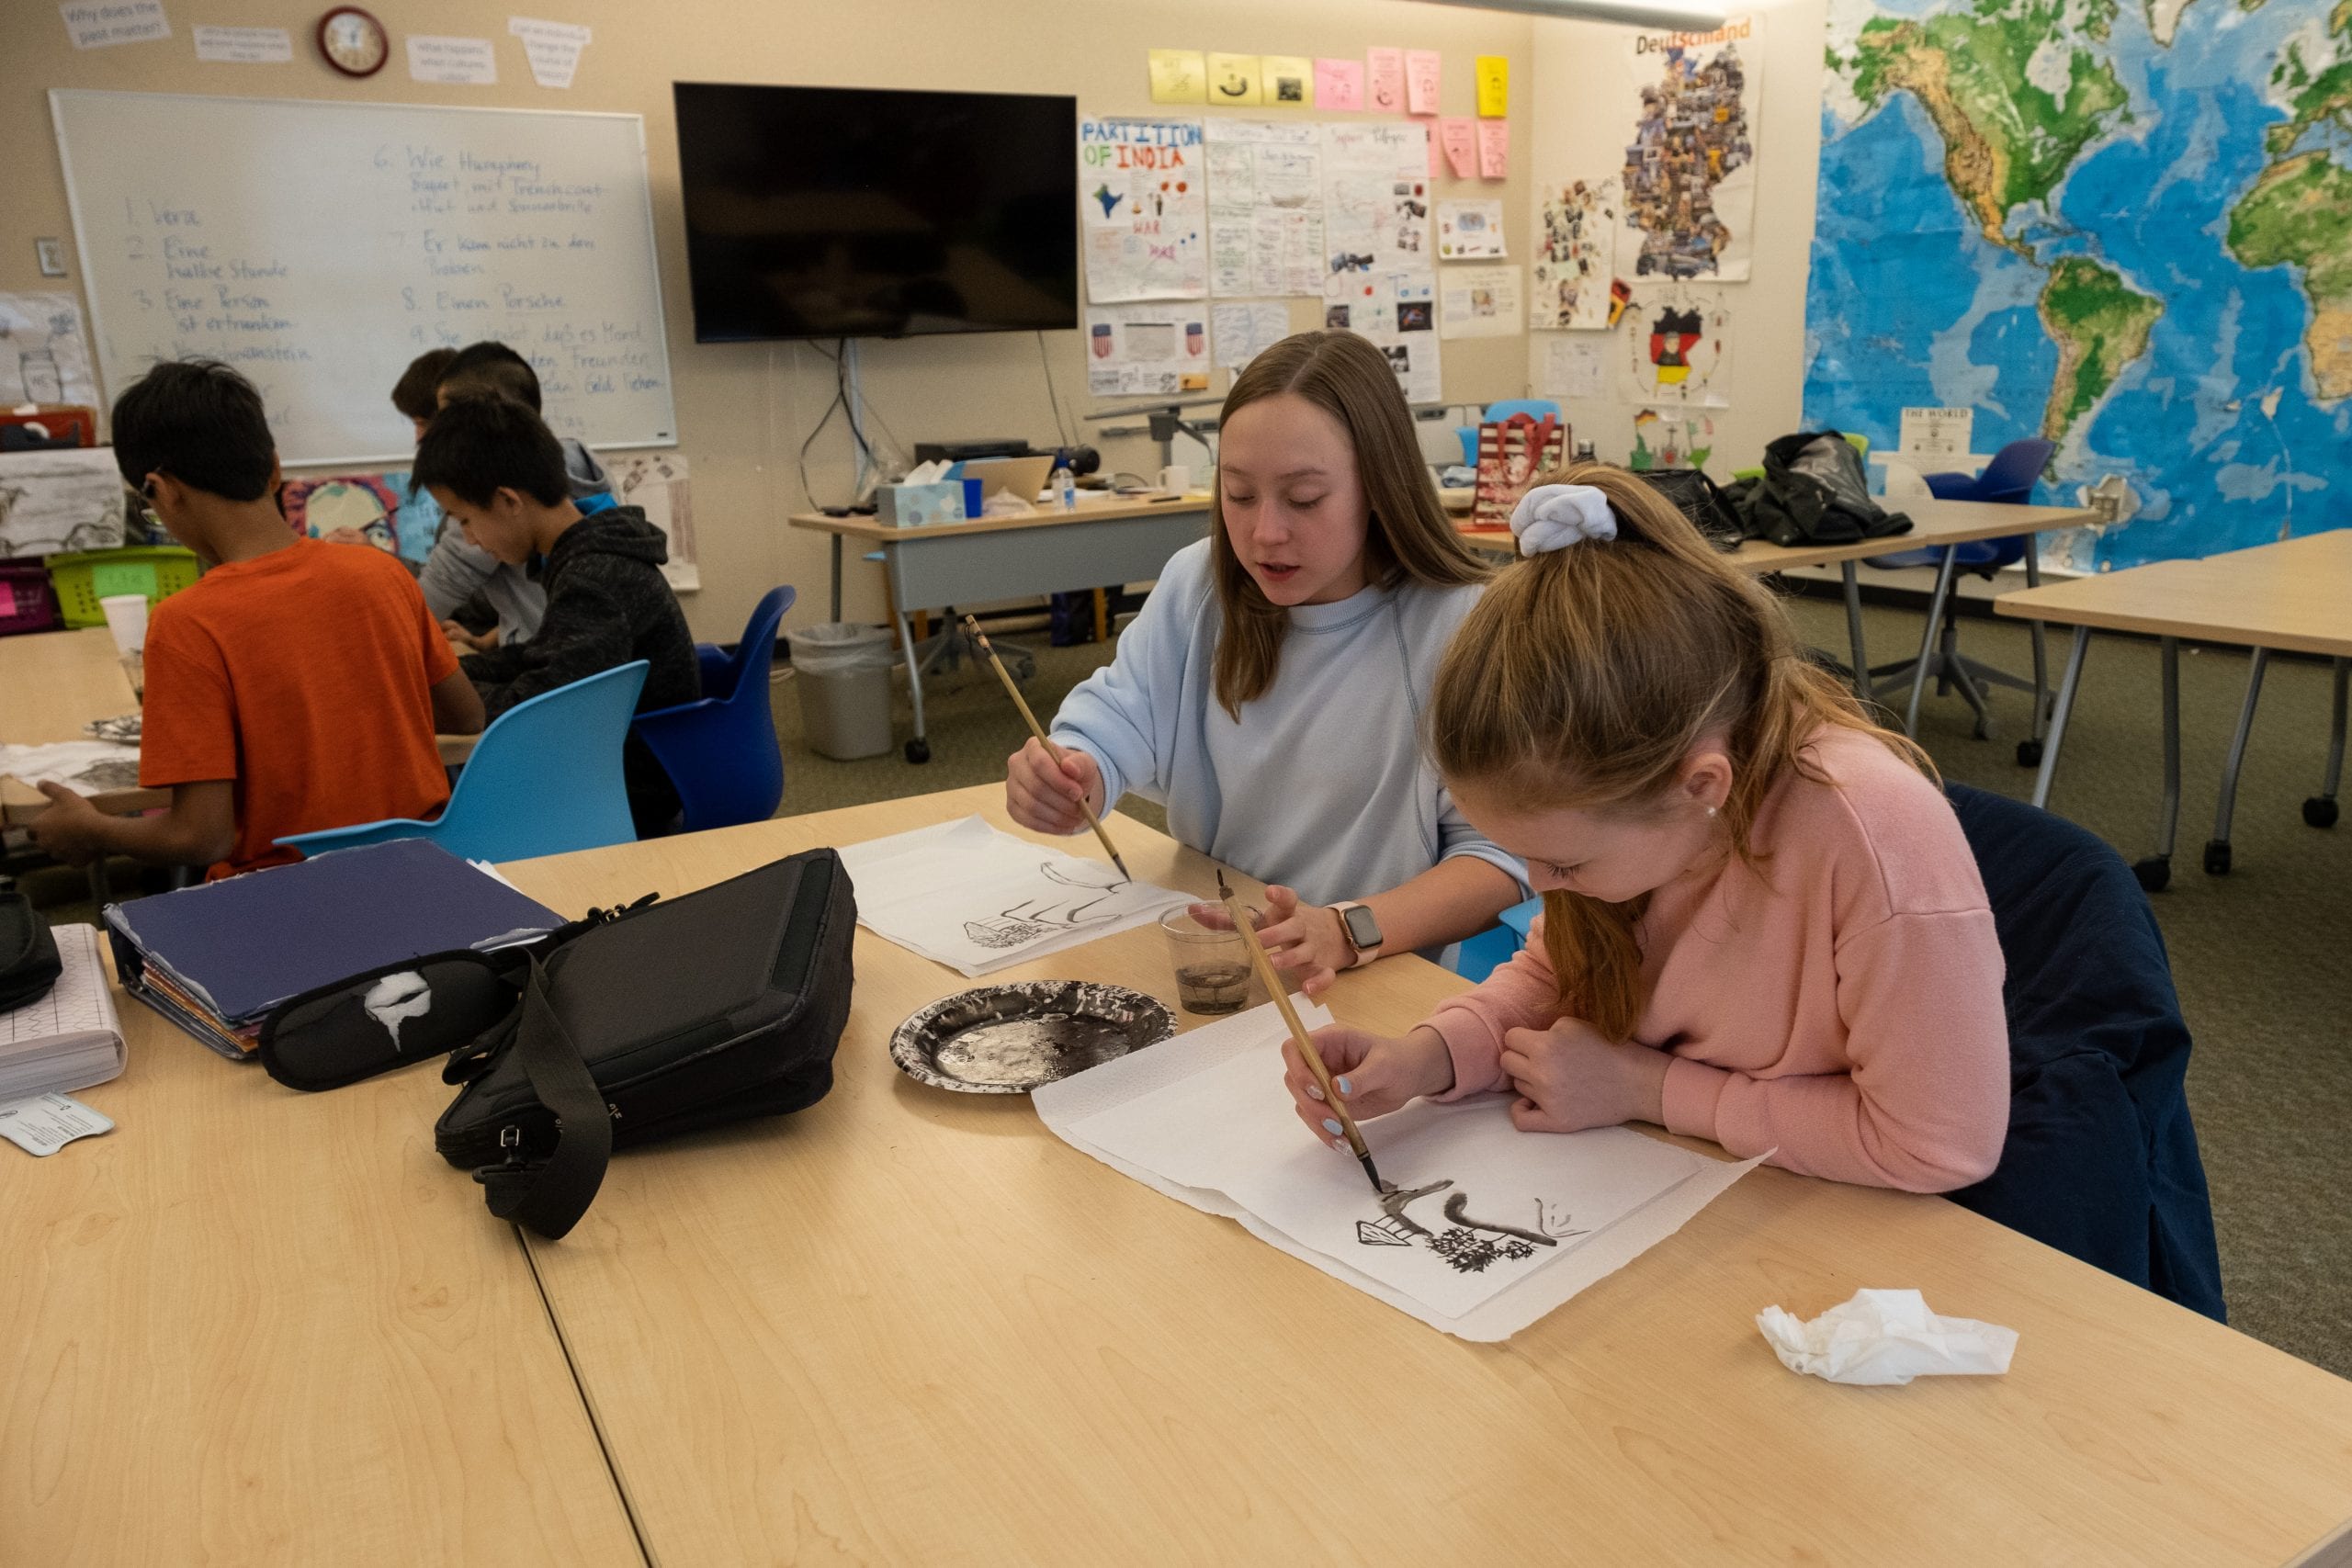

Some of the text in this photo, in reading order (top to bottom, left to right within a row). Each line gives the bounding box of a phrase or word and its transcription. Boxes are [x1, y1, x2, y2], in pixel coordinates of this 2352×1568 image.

[67, 3, 157, 23] Why does the
[79, 21, 160, 45] past matter?
[1081, 121, 1203, 148] PARTITION
[406, 144, 445, 169] Wie
[459, 150, 541, 183] Humphrey
[1084, 144, 1185, 170] OF INDIA
[471, 177, 503, 193] mit
[146, 198, 201, 226] Vera
[468, 199, 498, 213] und
[163, 235, 209, 260] Eine
[423, 228, 444, 254] Er
[497, 235, 536, 250] nicht
[228, 258, 288, 279] Stunde
[164, 288, 203, 312] Eine
[213, 284, 270, 310] Person
[435, 289, 490, 311] Einen
[497, 283, 565, 311] Porsche
[433, 321, 461, 344] Sie
[571, 346, 650, 369] Freunden
[1905, 409, 1968, 418] THE WORLD
